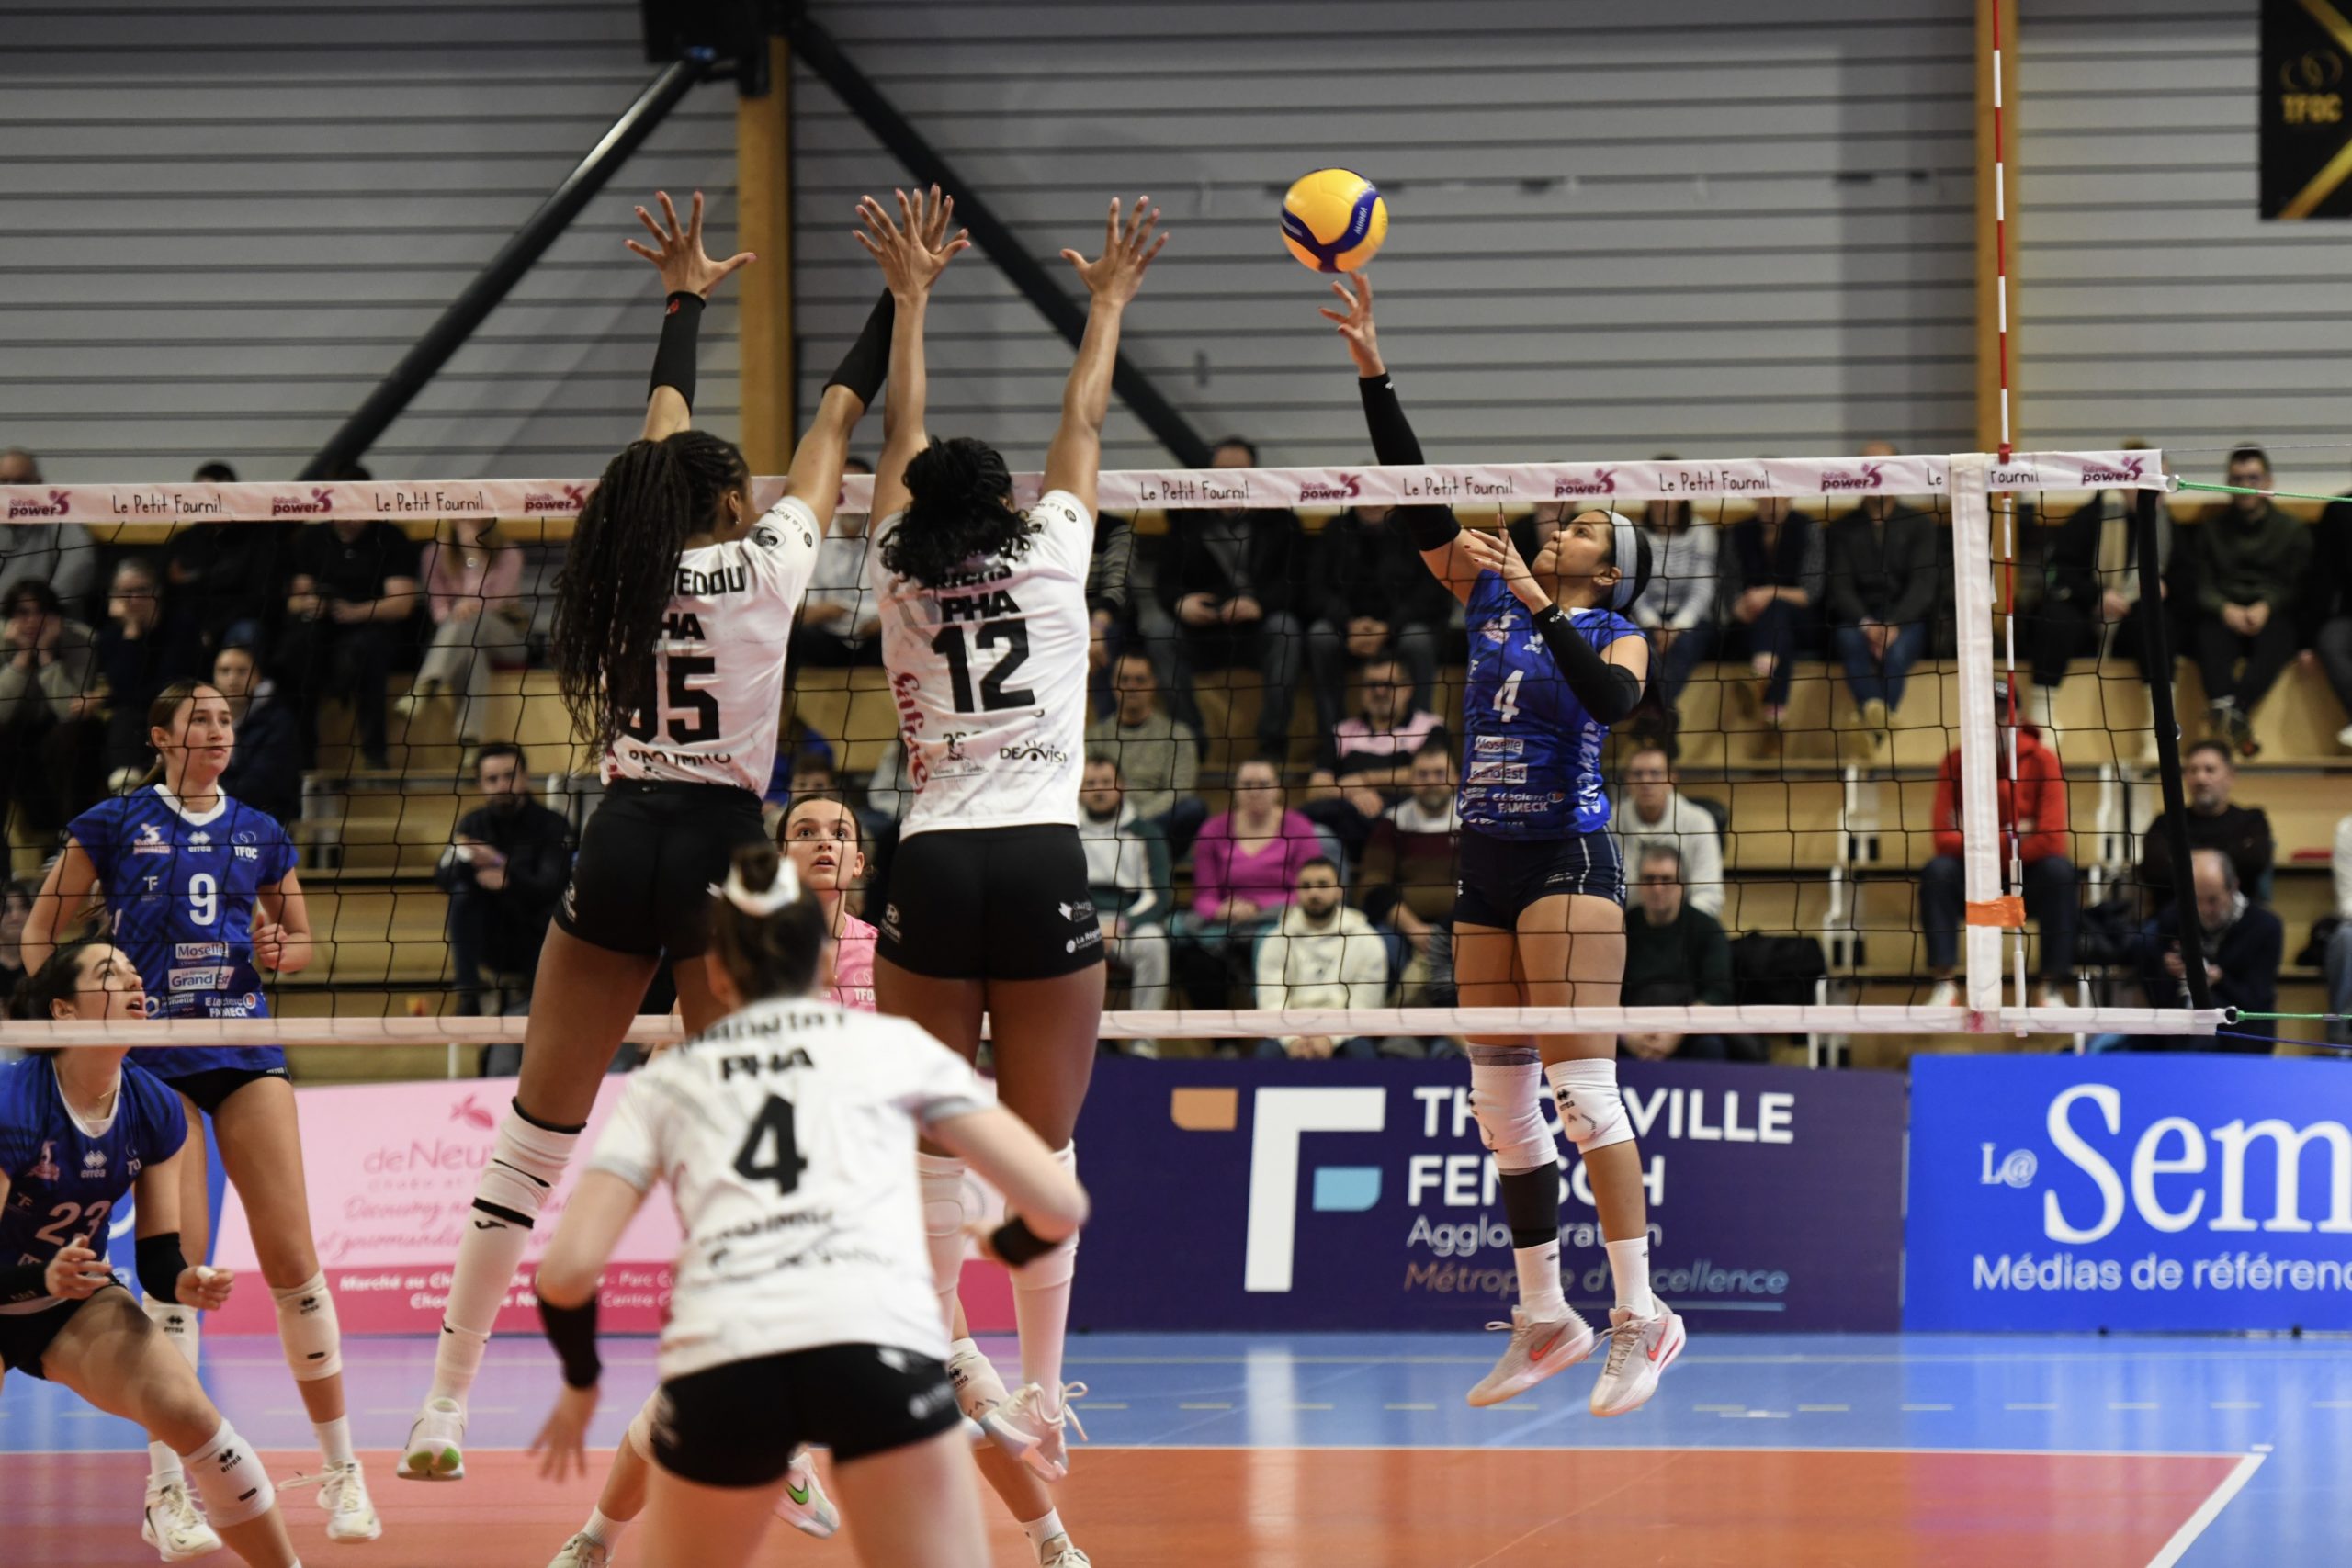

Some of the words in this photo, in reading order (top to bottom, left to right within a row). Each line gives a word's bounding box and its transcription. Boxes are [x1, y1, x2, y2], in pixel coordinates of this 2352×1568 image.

[1141, 481, 1155, 500] Le
[1162, 480, 1195, 500] Petit
[1202, 480, 1249, 500] Fournil
[1403, 478, 1419, 496] Le
[1426, 477, 1459, 496] Petit
[1465, 475, 1513, 495] Fournil
[1659, 473, 1675, 491] Le
[1680, 471, 1714, 491] Petit
[1722, 470, 1770, 491] Fournil
[1928, 467, 1942, 485] Le
[113, 495, 128, 513] Le
[134, 494, 167, 513] Petit
[175, 494, 221, 513] Fournil
[375, 492, 390, 512] Le
[397, 491, 430, 511] Petit
[435, 491, 484, 511] Fournil
[677, 566, 745, 595] EDOU
[662, 613, 706, 640] HA
[931, 618, 1035, 713] 12
[1492, 669, 1525, 723] 4
[1498, 802, 1548, 813] FAMECK
[234, 846, 258, 860] TFOC
[188, 873, 217, 926] 9
[171, 975, 213, 987] Grand
[1414, 1086, 1795, 1145] THVILLE
[733, 1093, 808, 1196] 4
[2044, 1083, 2352, 1244] Sem
[1406, 1213, 1663, 1258] Aggloratn
[1403, 1261, 1576, 1301] Métrope
[1973, 1253, 2121, 1290] Médias
[2132, 1253, 2184, 1290] de
